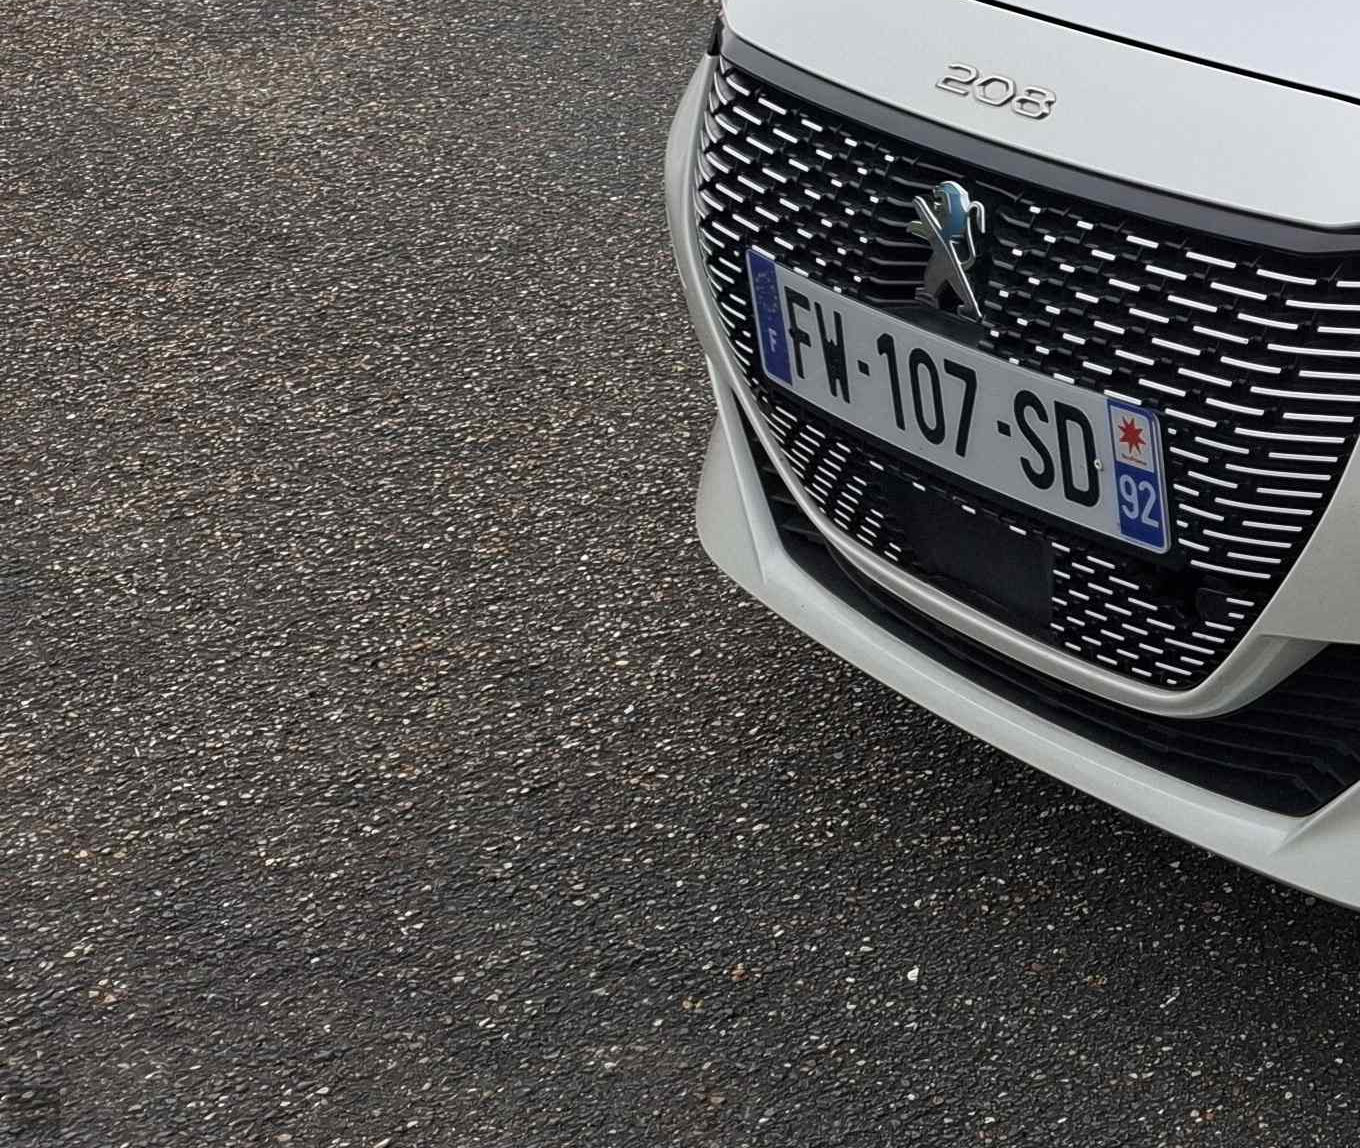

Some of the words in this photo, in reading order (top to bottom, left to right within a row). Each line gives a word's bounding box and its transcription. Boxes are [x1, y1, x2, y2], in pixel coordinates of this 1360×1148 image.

[935, 63, 1056, 120] 208
[768, 327, 778, 352] F
[784, 286, 1100, 507] FW-107-SD
[1119, 474, 1160, 528] 92
